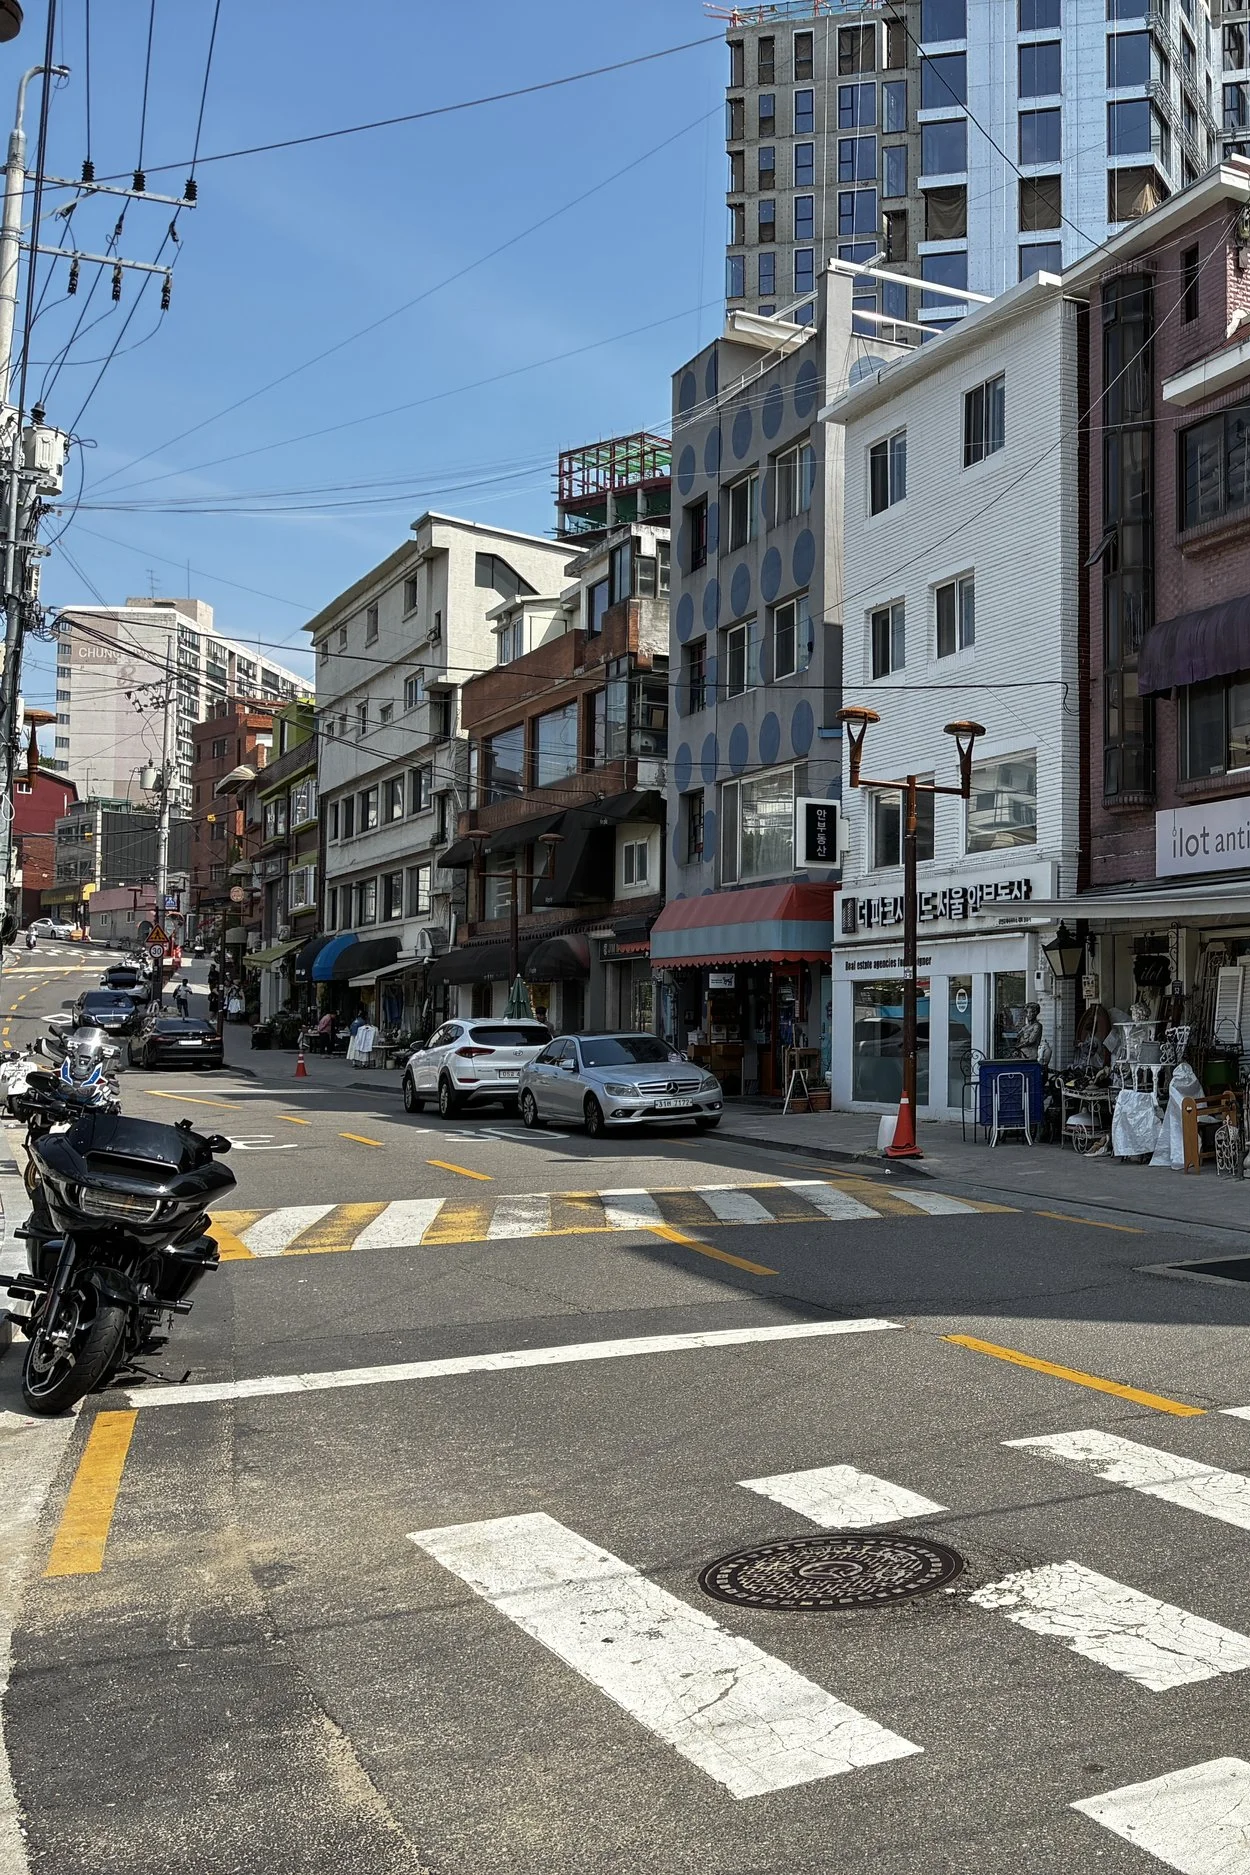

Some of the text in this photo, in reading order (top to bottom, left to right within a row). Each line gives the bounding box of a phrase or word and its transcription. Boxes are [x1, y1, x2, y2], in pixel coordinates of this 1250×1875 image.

[816, 809, 827, 857] 안부동산
[1172, 826, 1210, 859] ilot
[857, 897, 869, 927] 더
[871, 891, 935, 927] 파크사드
[937, 888, 967, 921] 서울
[845, 960, 856, 971] Real
[857, 959, 872, 970] estate
[874, 958, 897, 970] agencies
